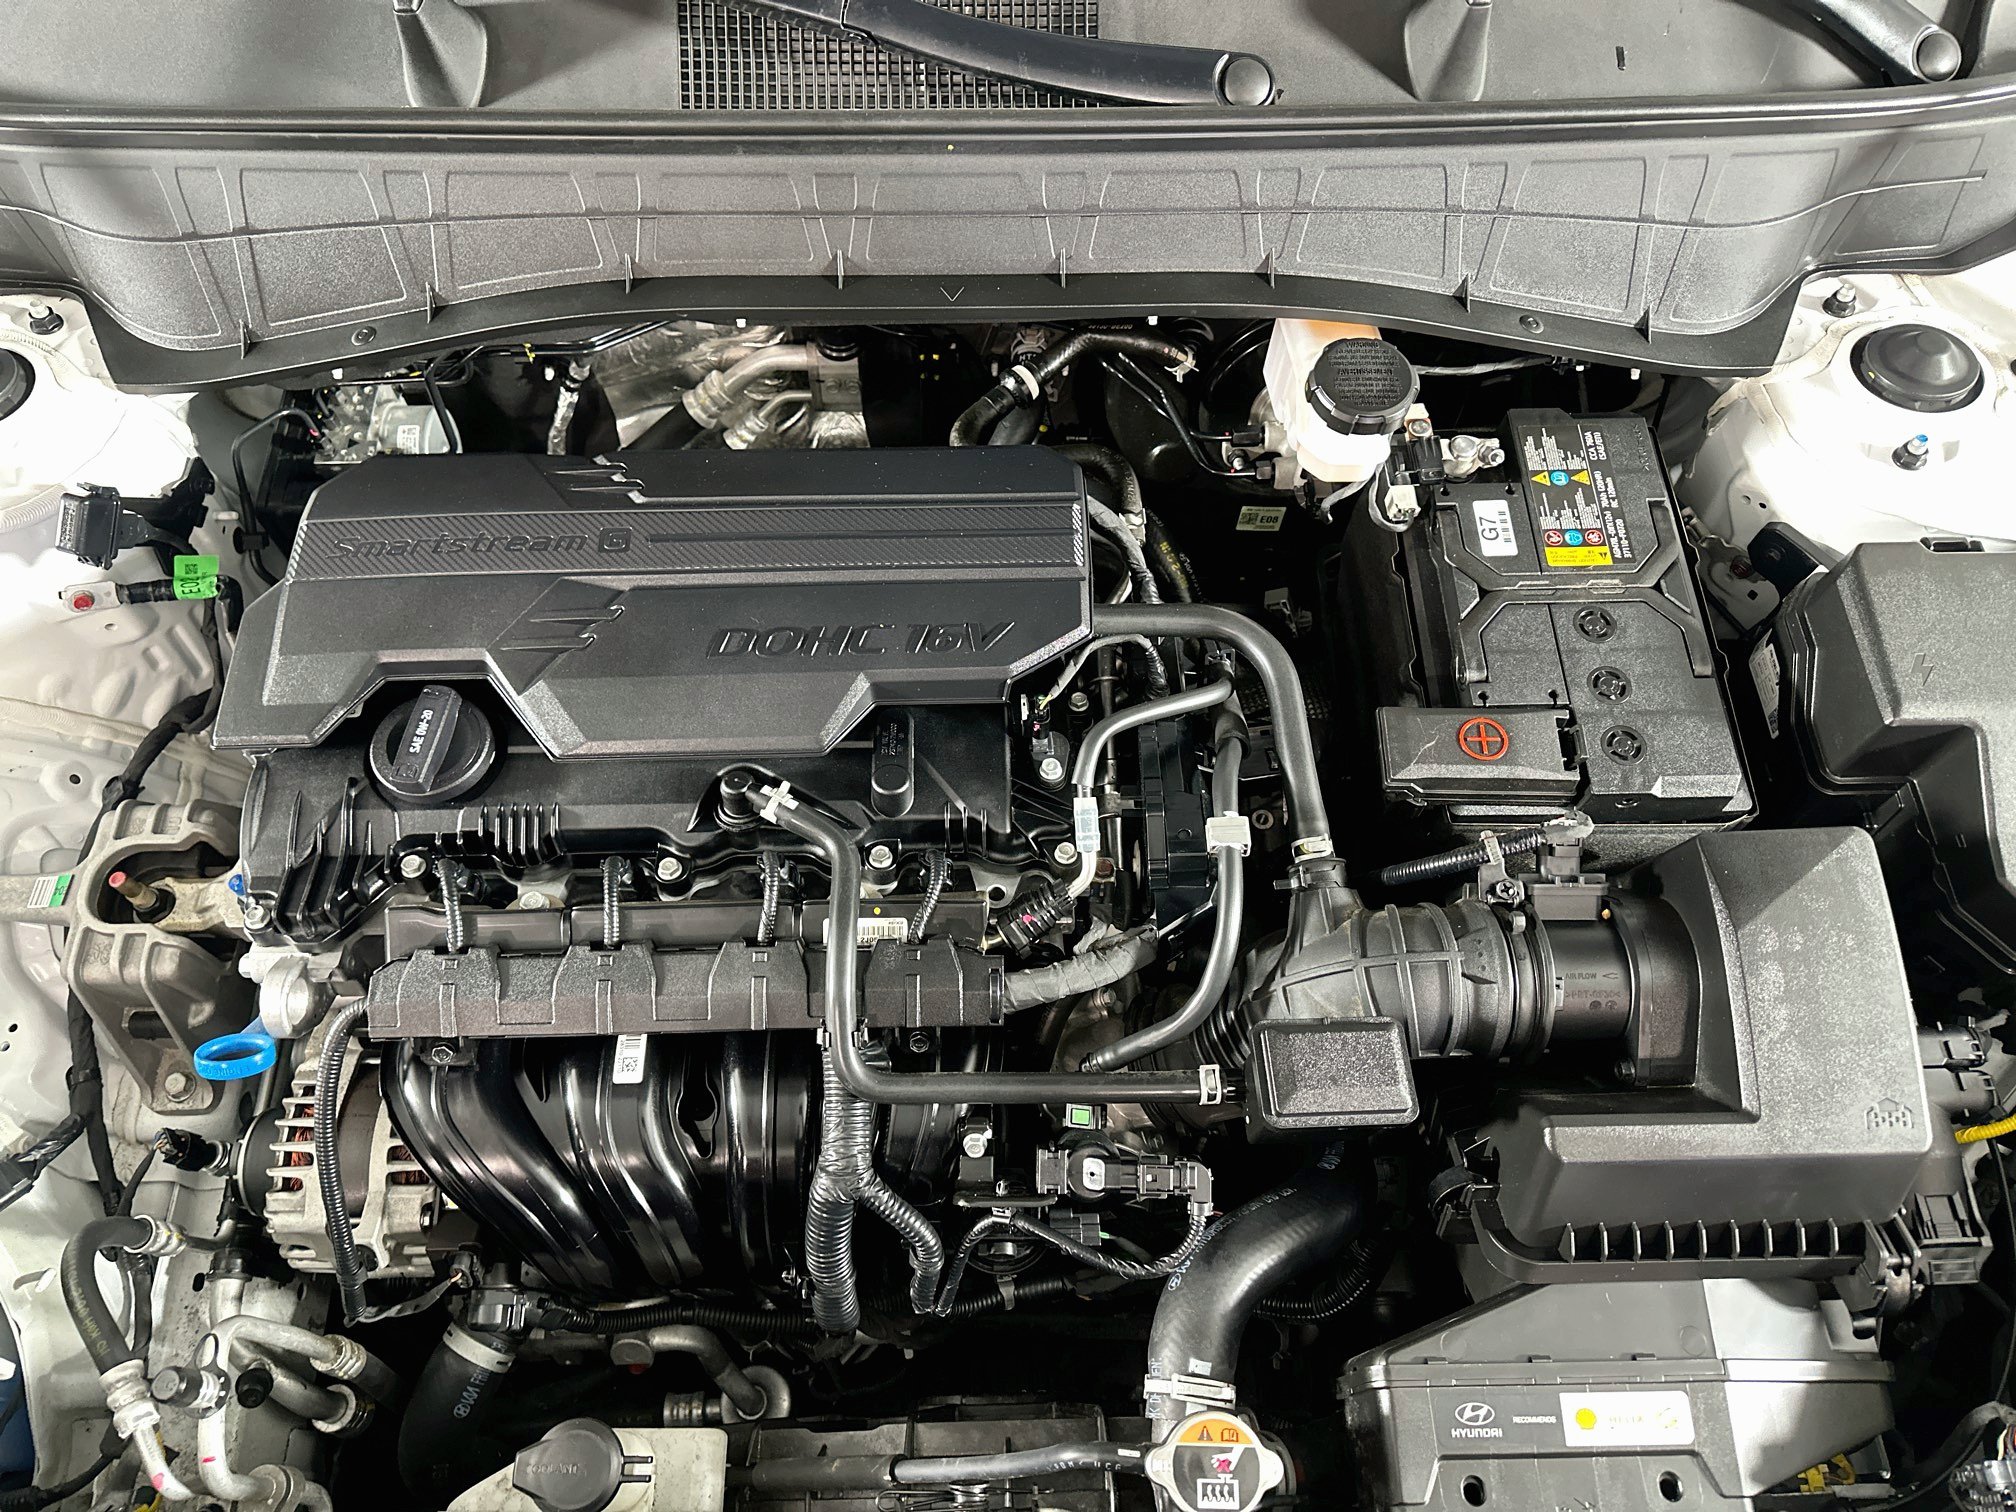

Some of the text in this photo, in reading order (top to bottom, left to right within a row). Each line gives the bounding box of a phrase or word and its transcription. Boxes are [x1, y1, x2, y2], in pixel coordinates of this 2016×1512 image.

[1587, 446, 1598, 461] CCA
[1259, 515, 1279, 524] E08
[1479, 516, 1499, 541] G7
[325, 530, 589, 559] Smartstream
[706, 621, 1015, 659] DOHC 16V
[409, 709, 434, 754] SAE 0W-20
[1565, 972, 1597, 980] AIR FLOW
[1451, 1427, 1503, 1439] HYUNDAI
[1512, 1415, 1557, 1424] RECOMMENDS
